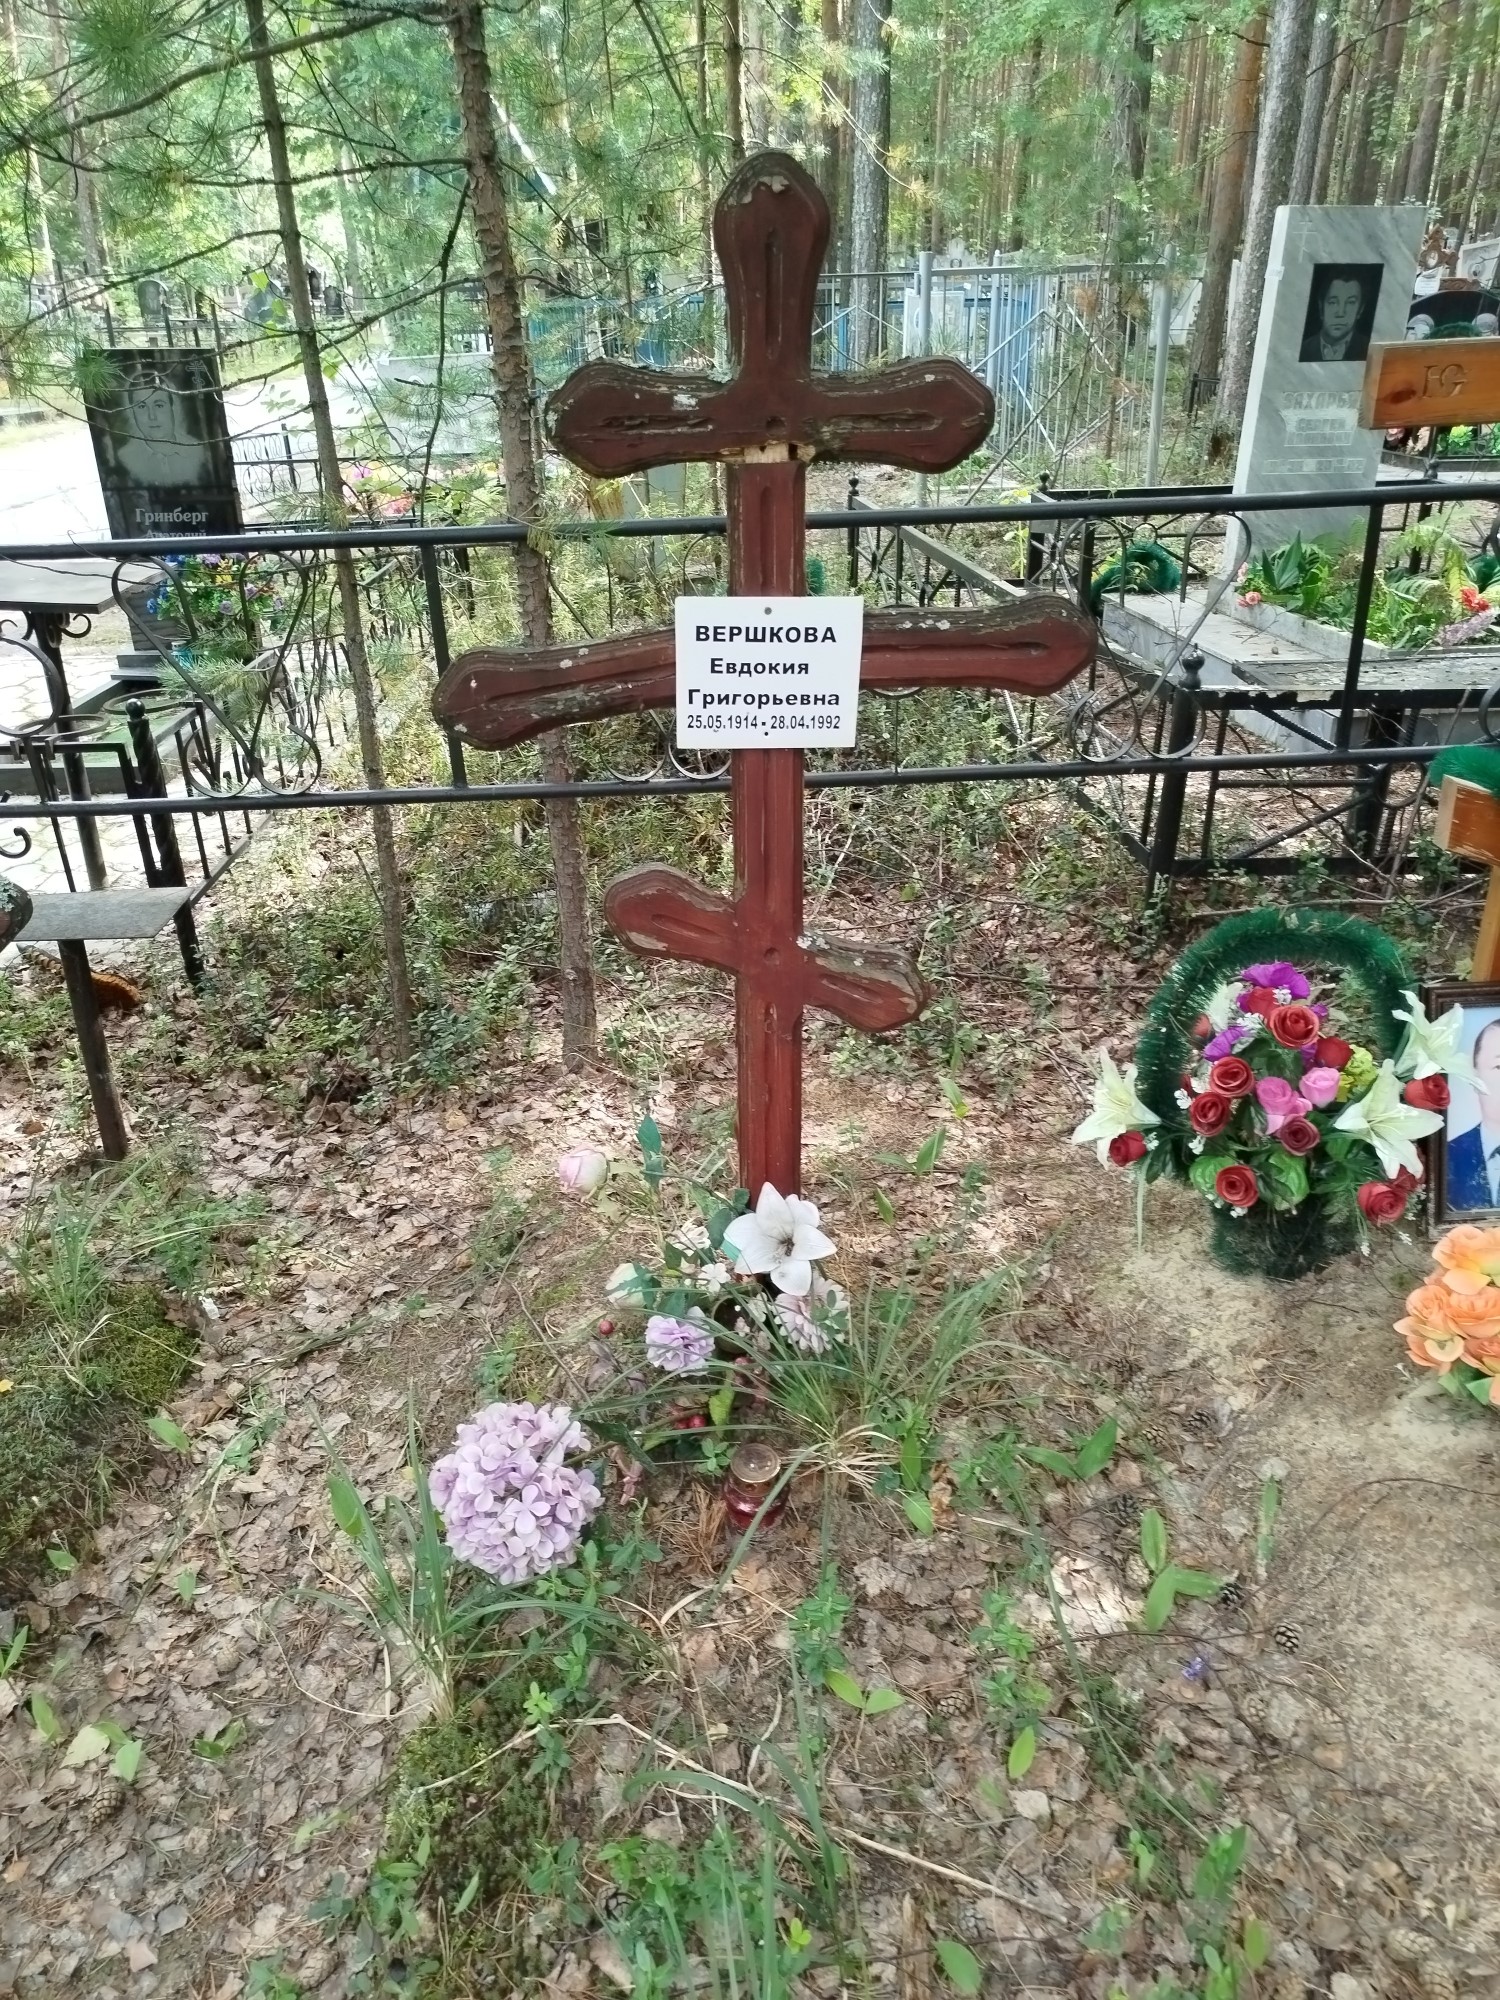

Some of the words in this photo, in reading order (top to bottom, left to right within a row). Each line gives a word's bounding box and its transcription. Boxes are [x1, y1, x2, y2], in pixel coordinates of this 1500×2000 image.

[135, 506, 209, 525] Гринберг
[695, 625, 837, 643] ВЕРШКОВА
[710, 657, 809, 677] Евдокия
[688, 688, 840, 709] Григорьевна
[687, 714, 758, 729] 25.05.1914
[770, 715, 841, 729] 28.04.1992
